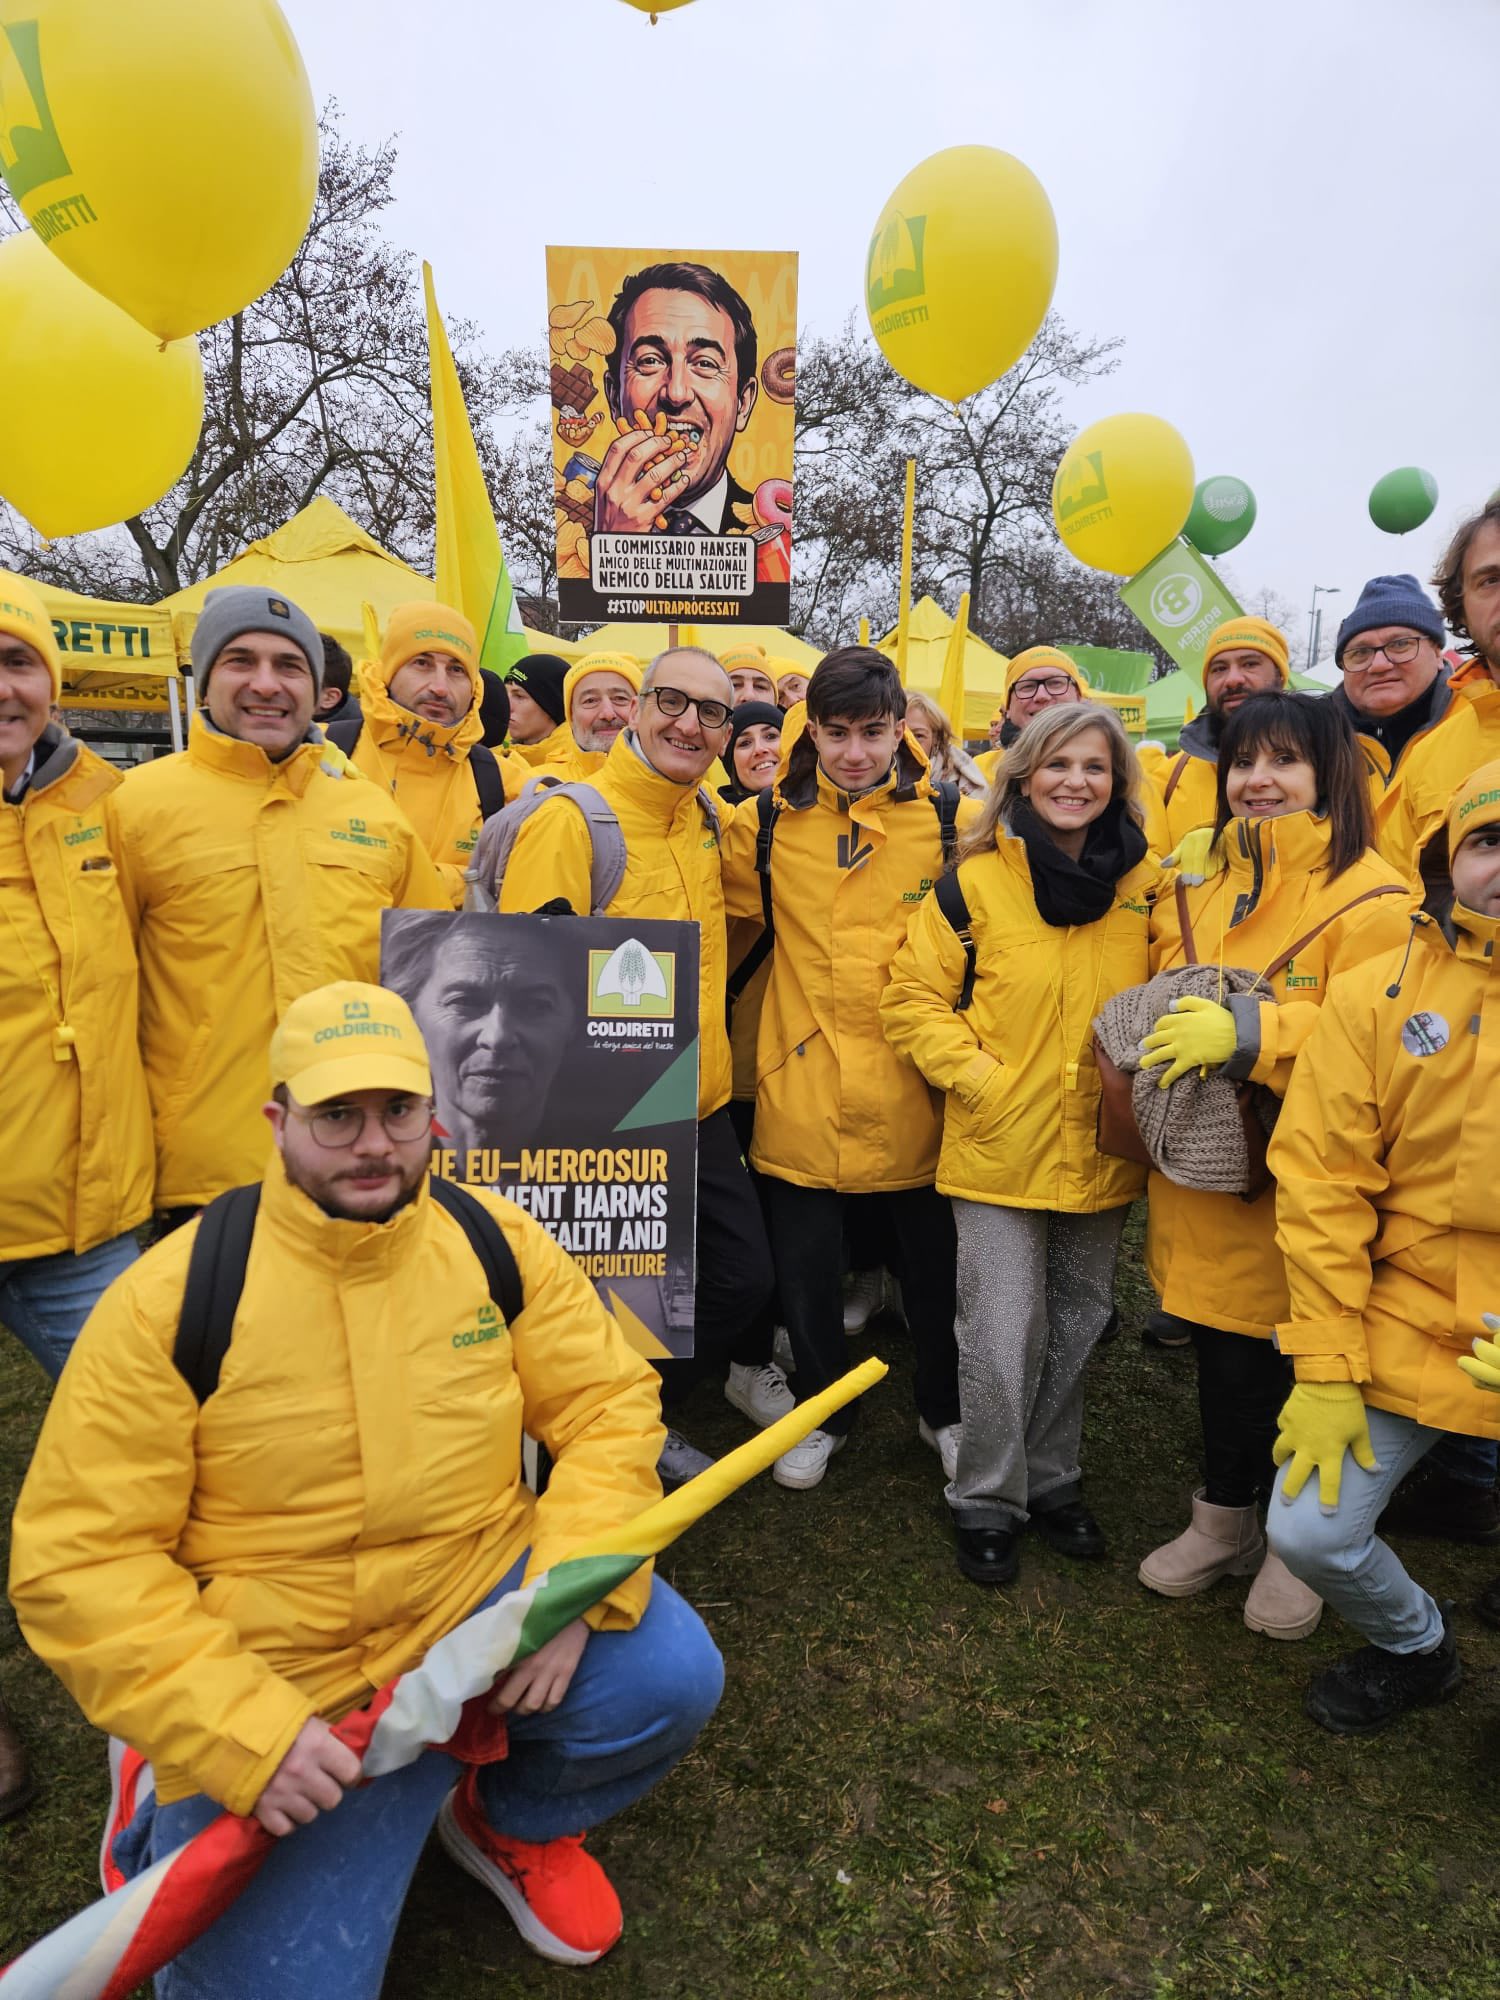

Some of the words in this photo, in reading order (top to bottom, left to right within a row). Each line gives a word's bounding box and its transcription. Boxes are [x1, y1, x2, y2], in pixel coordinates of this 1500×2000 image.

[599, 539, 610, 555] IL
[614, 539, 696, 556] COMMISSARIO
[700, 541, 748, 558] HANSEN
[599, 557, 630, 569] AMICO
[633, 557, 662, 571] DELLE
[666, 558, 748, 573] MULTINAZIONALI
[599, 571, 650, 589] NEMICO
[655, 572, 694, 590] DELLA
[699, 573, 747, 591] SALUTE
[607, 599, 740, 617] #STOPULTRAPROCESSATI
[51, 619, 151, 658] RETTI
[1287, 976, 1318, 987] RETTI
[314, 1022, 402, 1044] COLDIRETTI
[587, 1021, 675, 1038] COLDIRETTI
[487, 1184, 567, 1219] MENT
[574, 1184, 668, 1219] HARMS
[544, 1221, 611, 1252] EALTH
[618, 1220, 668, 1251] AND
[574, 1253, 667, 1278] RICULTURE
